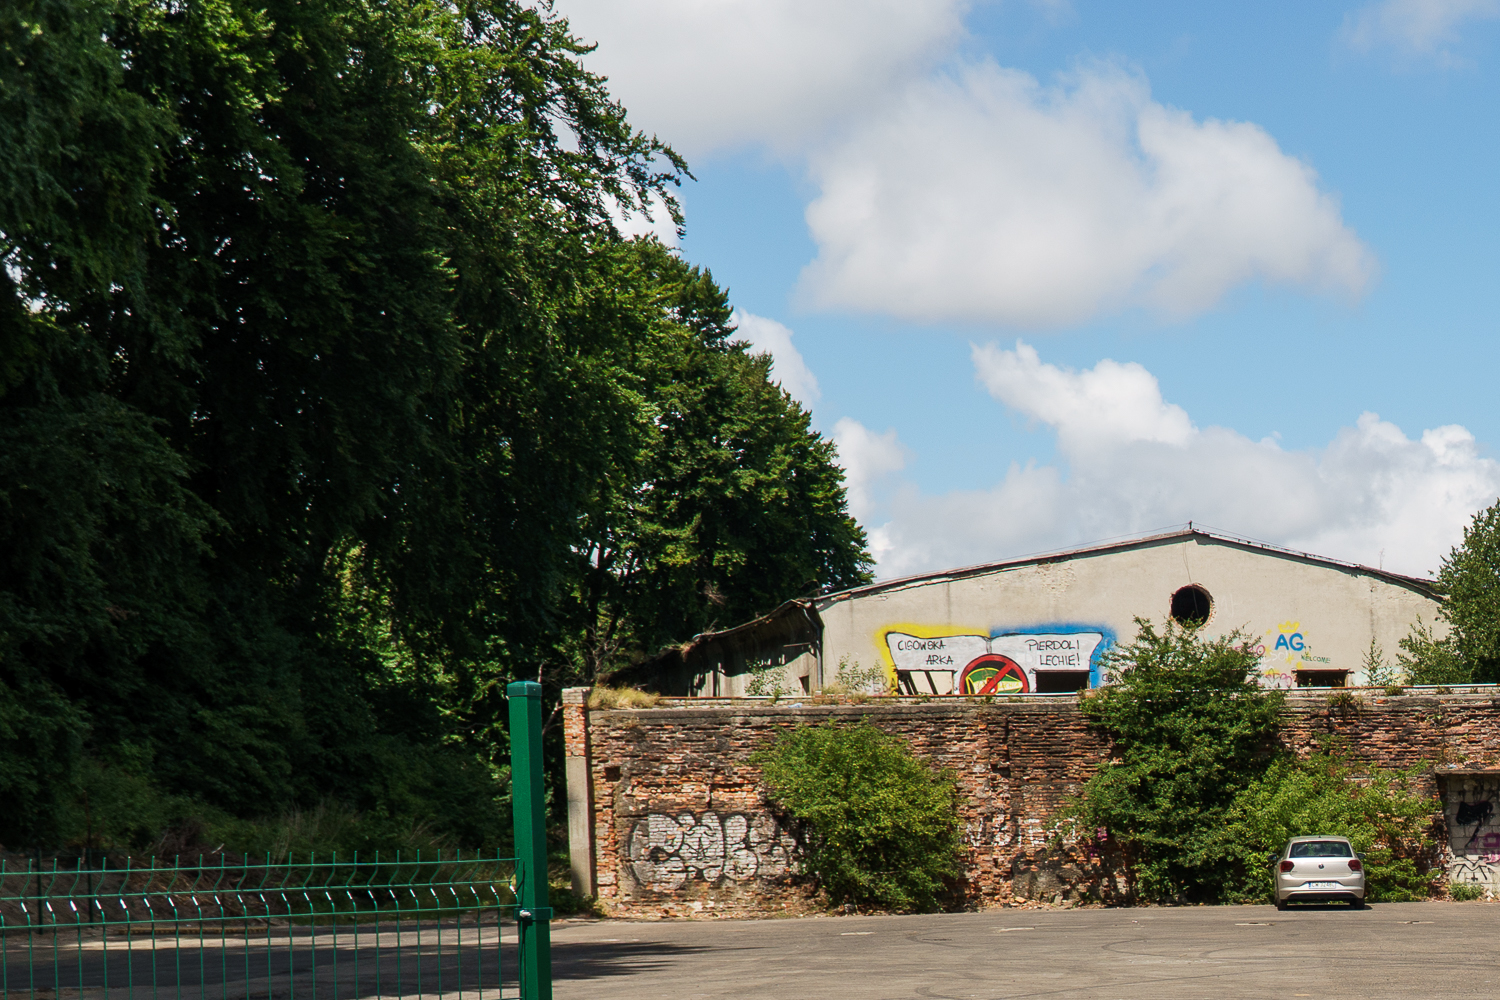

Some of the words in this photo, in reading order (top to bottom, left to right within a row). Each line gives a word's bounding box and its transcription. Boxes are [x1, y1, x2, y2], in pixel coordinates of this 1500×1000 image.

[897, 640, 946, 651] CISOWSKA
[1274, 632, 1305, 651] AG
[925, 654, 954, 665] ARKA
[1039, 652, 1080, 667] LECHIE!
